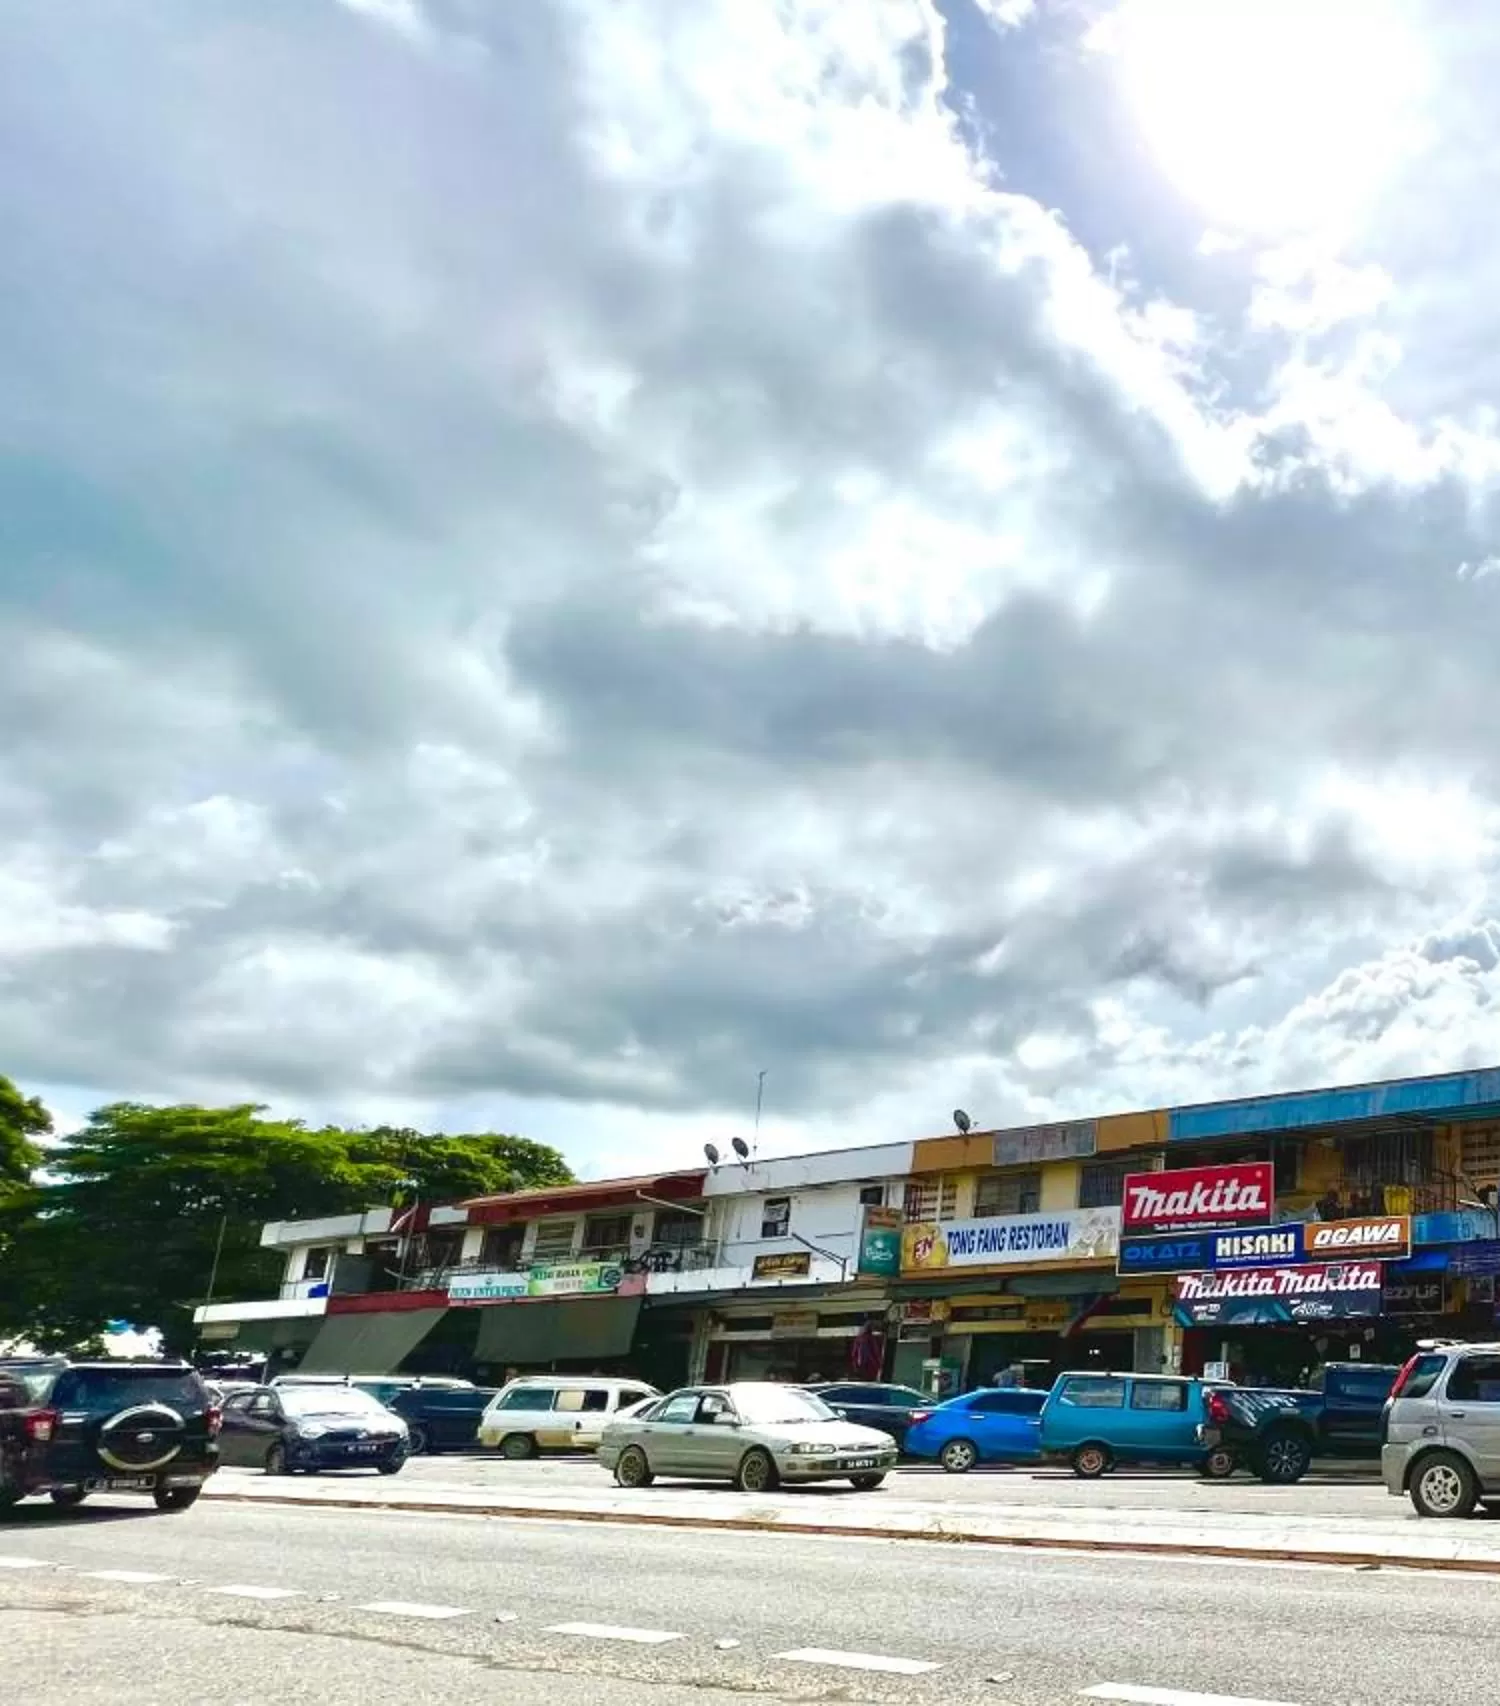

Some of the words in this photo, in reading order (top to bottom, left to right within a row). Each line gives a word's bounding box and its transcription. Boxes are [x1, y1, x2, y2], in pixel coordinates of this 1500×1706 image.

[1128, 1178, 1267, 1219] Makita
[946, 1228, 976, 1257] TONG
[976, 1226, 1006, 1254] FANG
[1008, 1221, 1071, 1252] RESTORAN
[1216, 1232, 1296, 1257] HISAKI
[1313, 1223, 1402, 1245] OGAWA
